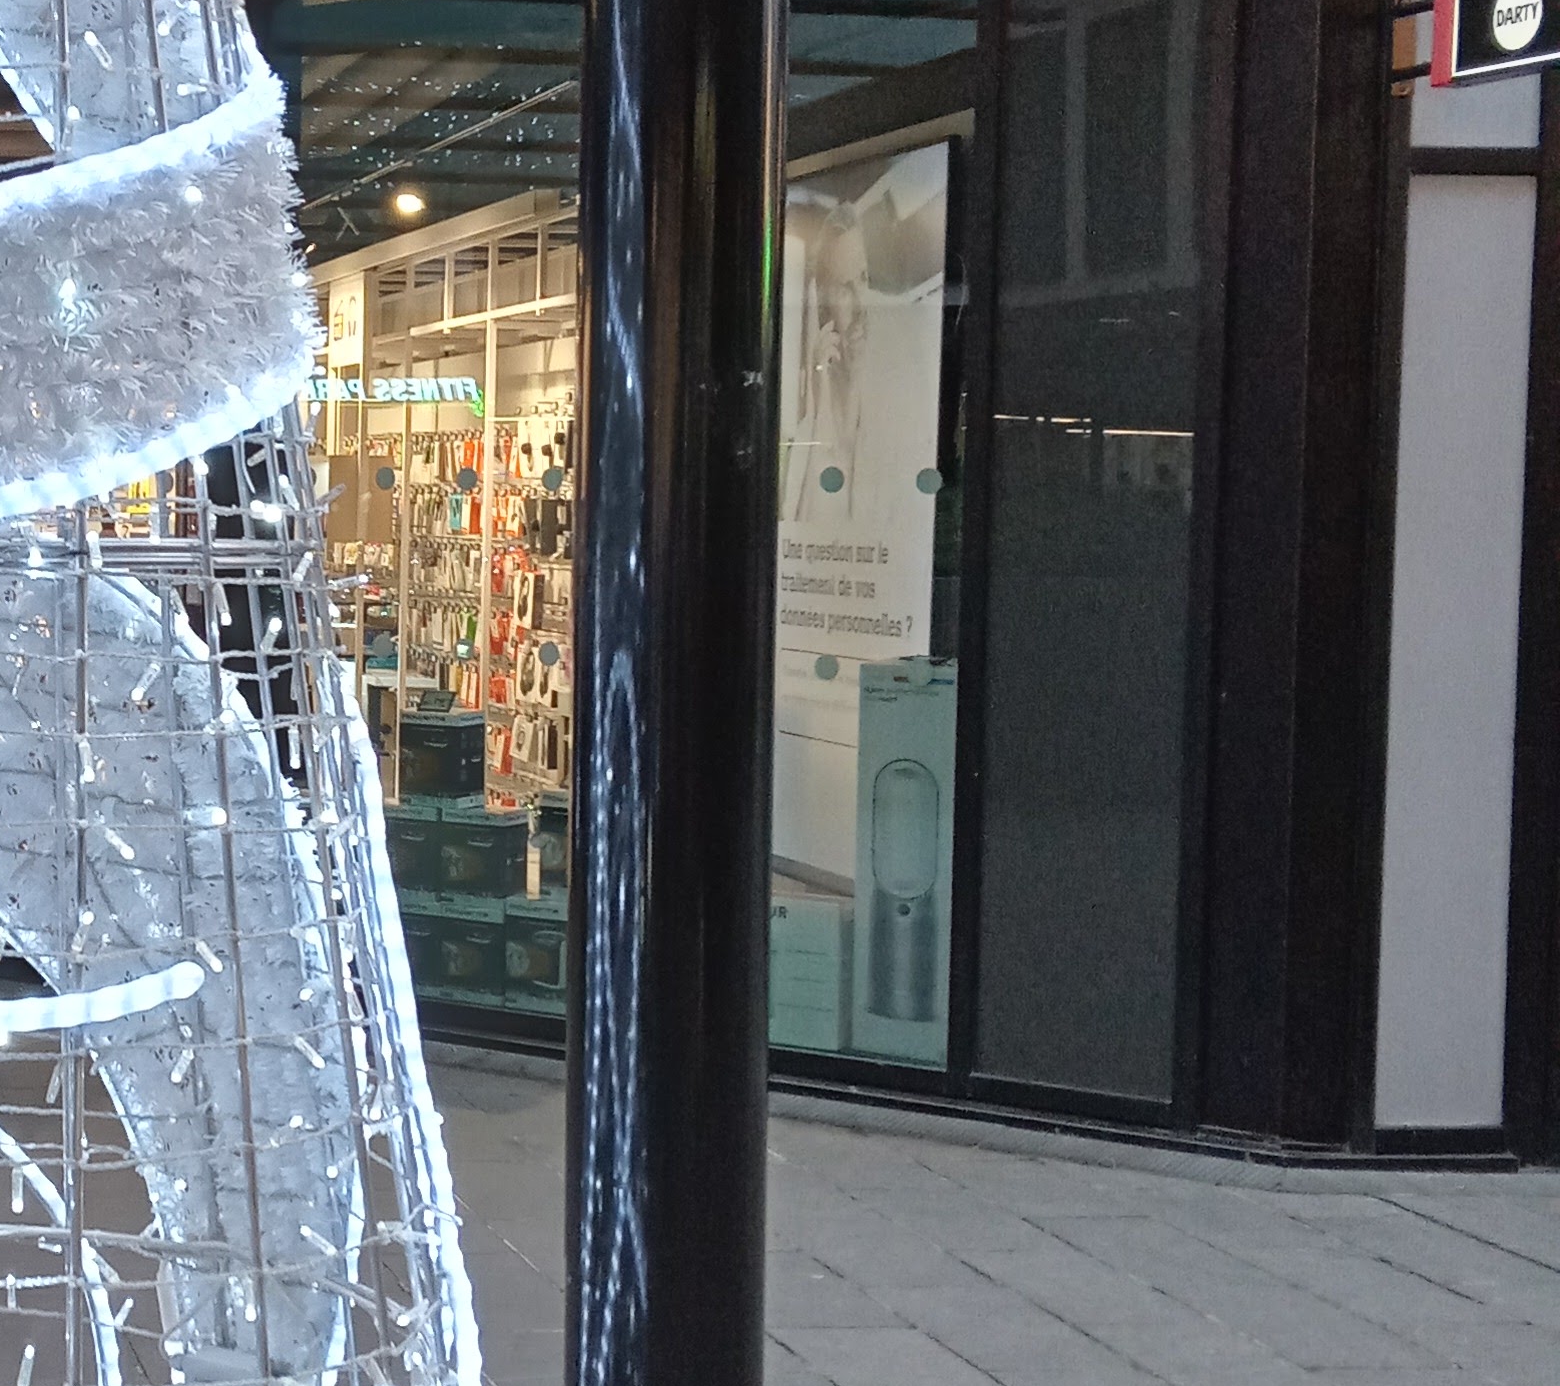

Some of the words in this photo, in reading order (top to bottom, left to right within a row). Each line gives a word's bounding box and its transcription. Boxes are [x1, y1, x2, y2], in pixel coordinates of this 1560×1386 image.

[1496, 1, 1540, 27] DARTY
[782, 538, 802, 560] Une
[805, 539, 852, 564] question
[856, 545, 875, 563] sur
[878, 541, 889, 564] le
[781, 573, 835, 596] traitement
[839, 575, 852, 596] de
[855, 583, 876, 600] vos
[781, 605, 825, 629] données
[827, 612, 902, 638] personnelles
